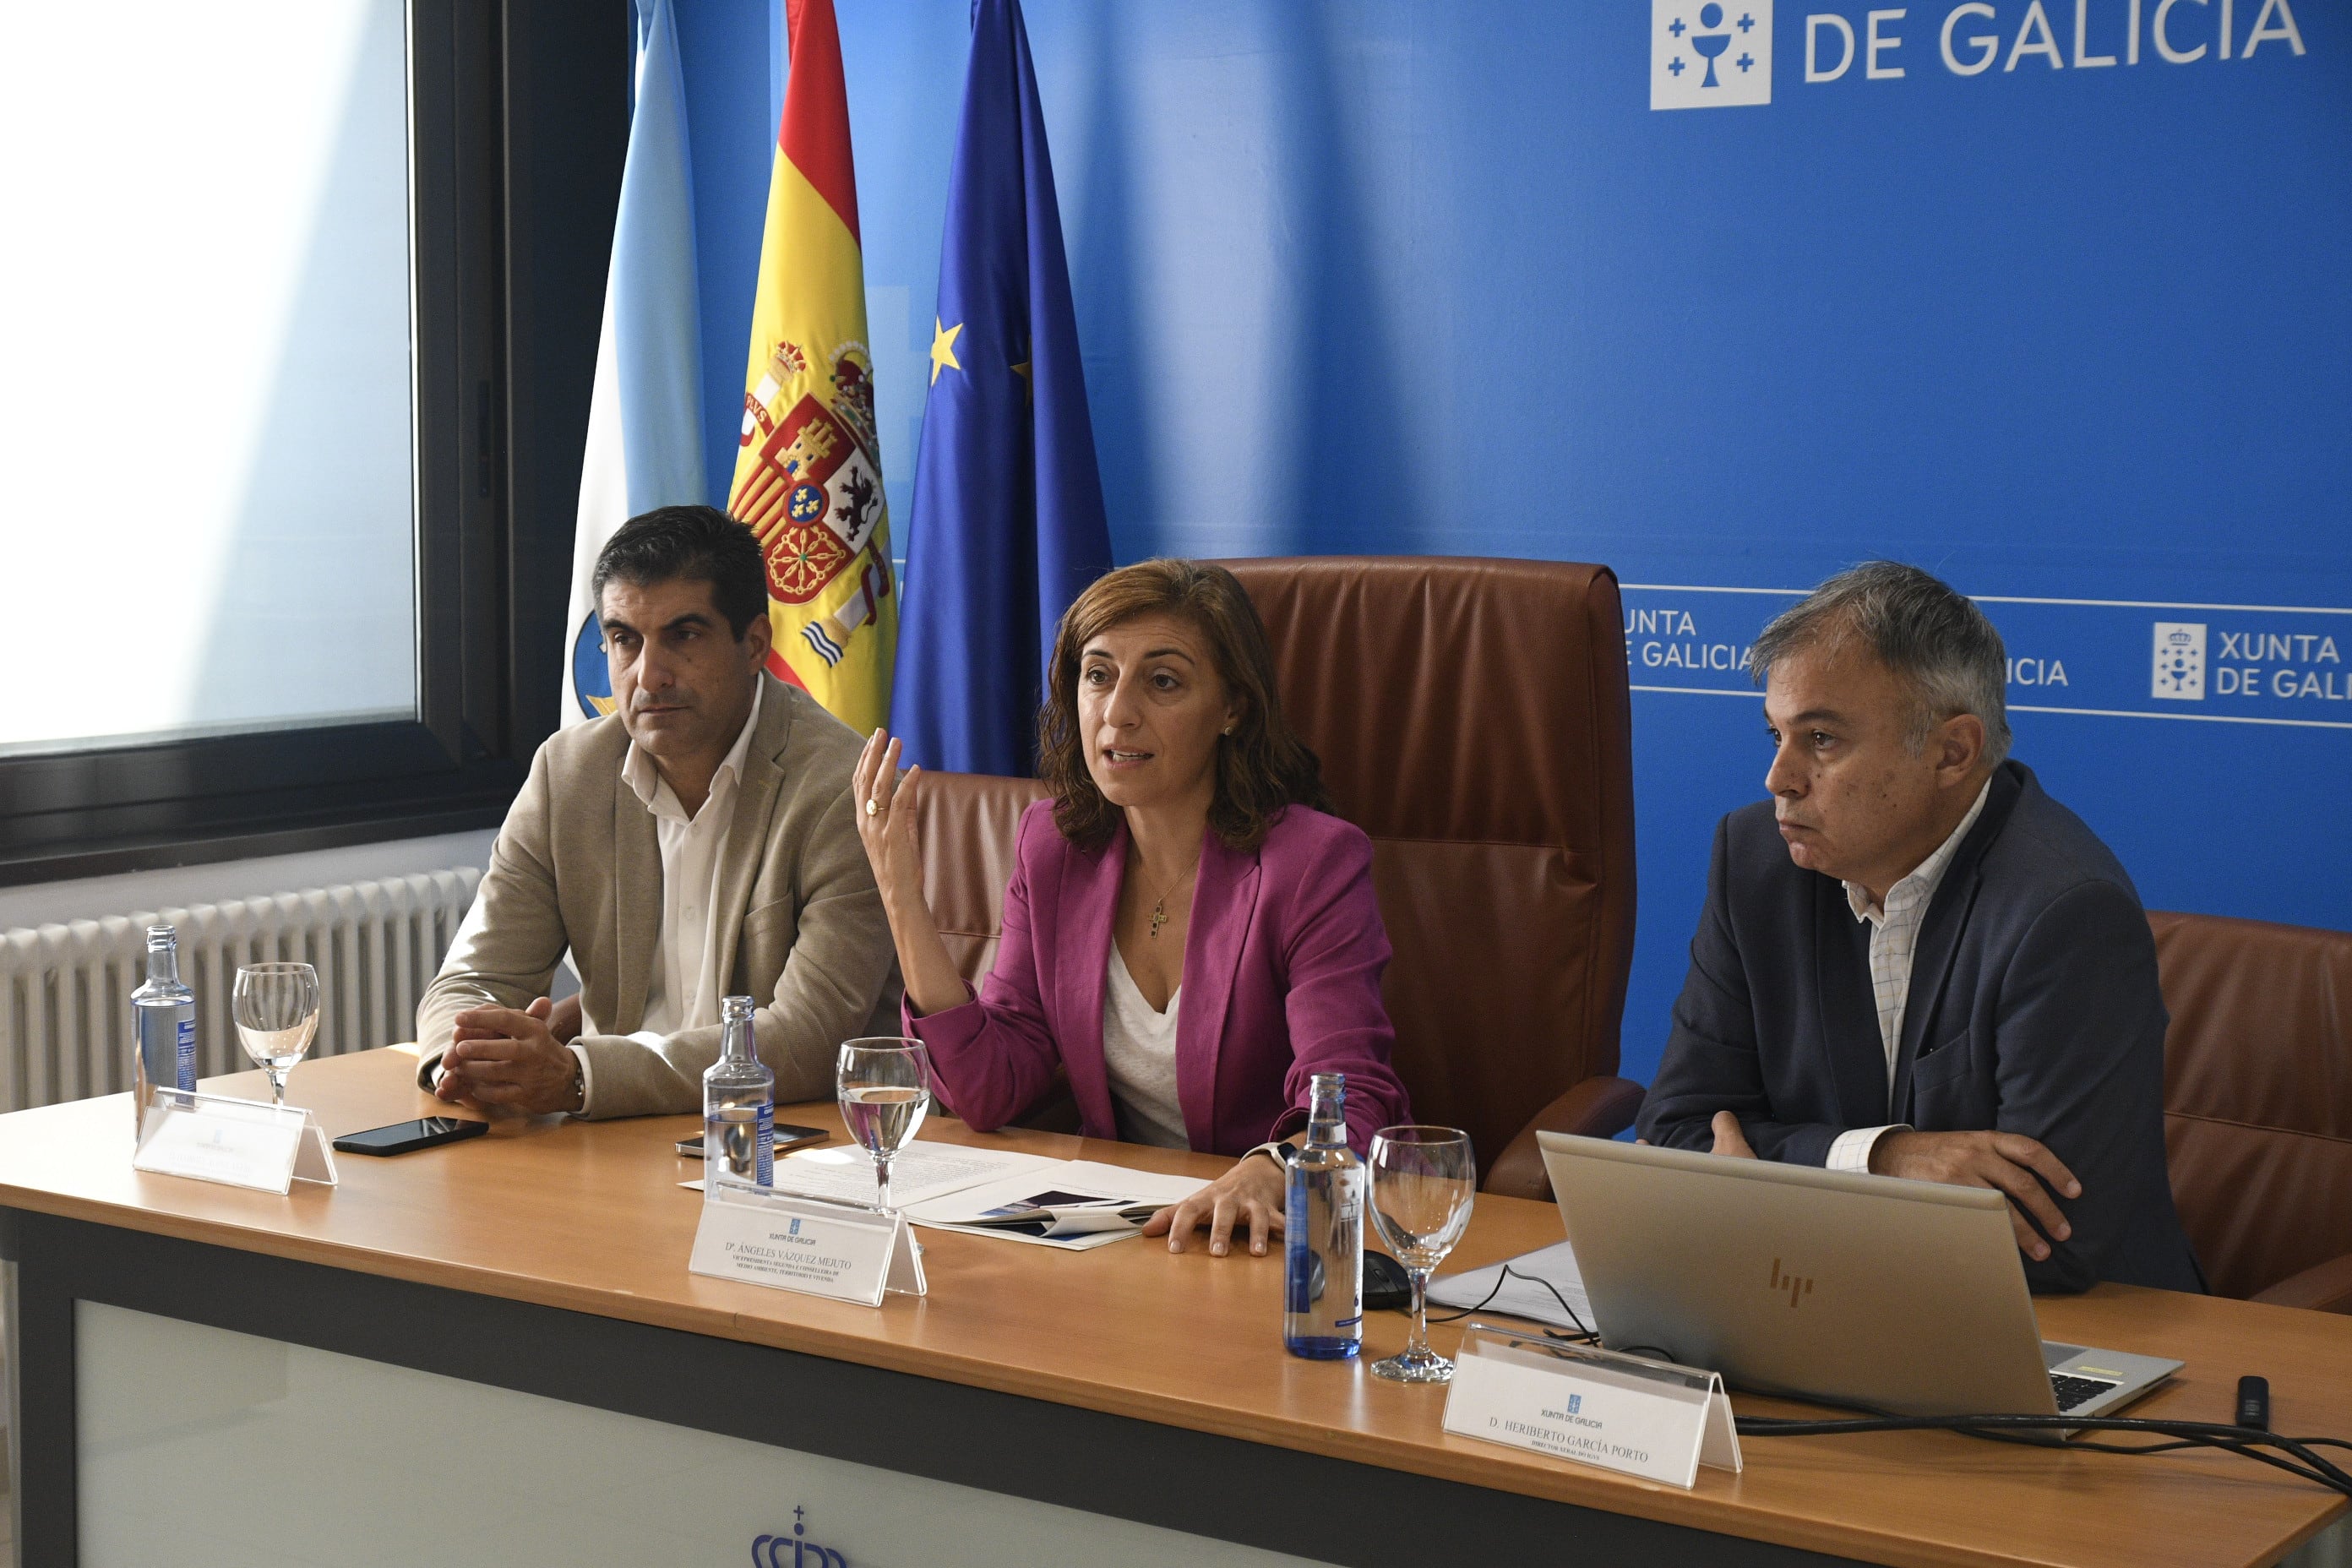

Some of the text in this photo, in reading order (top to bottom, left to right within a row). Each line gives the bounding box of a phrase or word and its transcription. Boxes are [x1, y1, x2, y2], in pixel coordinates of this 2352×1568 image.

[1805, 0, 2306, 83] DE GALICIA
[746, 395, 767, 422] PLVS
[1625, 608, 1696, 635] UNTA
[2219, 631, 2341, 664] XUNTA
[2006, 657, 2069, 686] ICIA
[2216, 667, 2352, 700] DE GALI
[738, 1241, 776, 1258] ÁNGELES
[778, 1248, 817, 1266] VÁZQUEZ
[818, 1256, 852, 1271] MEJUTO
[1541, 1408, 1603, 1429] XUNTA DE GALICIA
[1489, 1417, 1648, 1462] D. HERIBERTO GARCÍA PORTO
